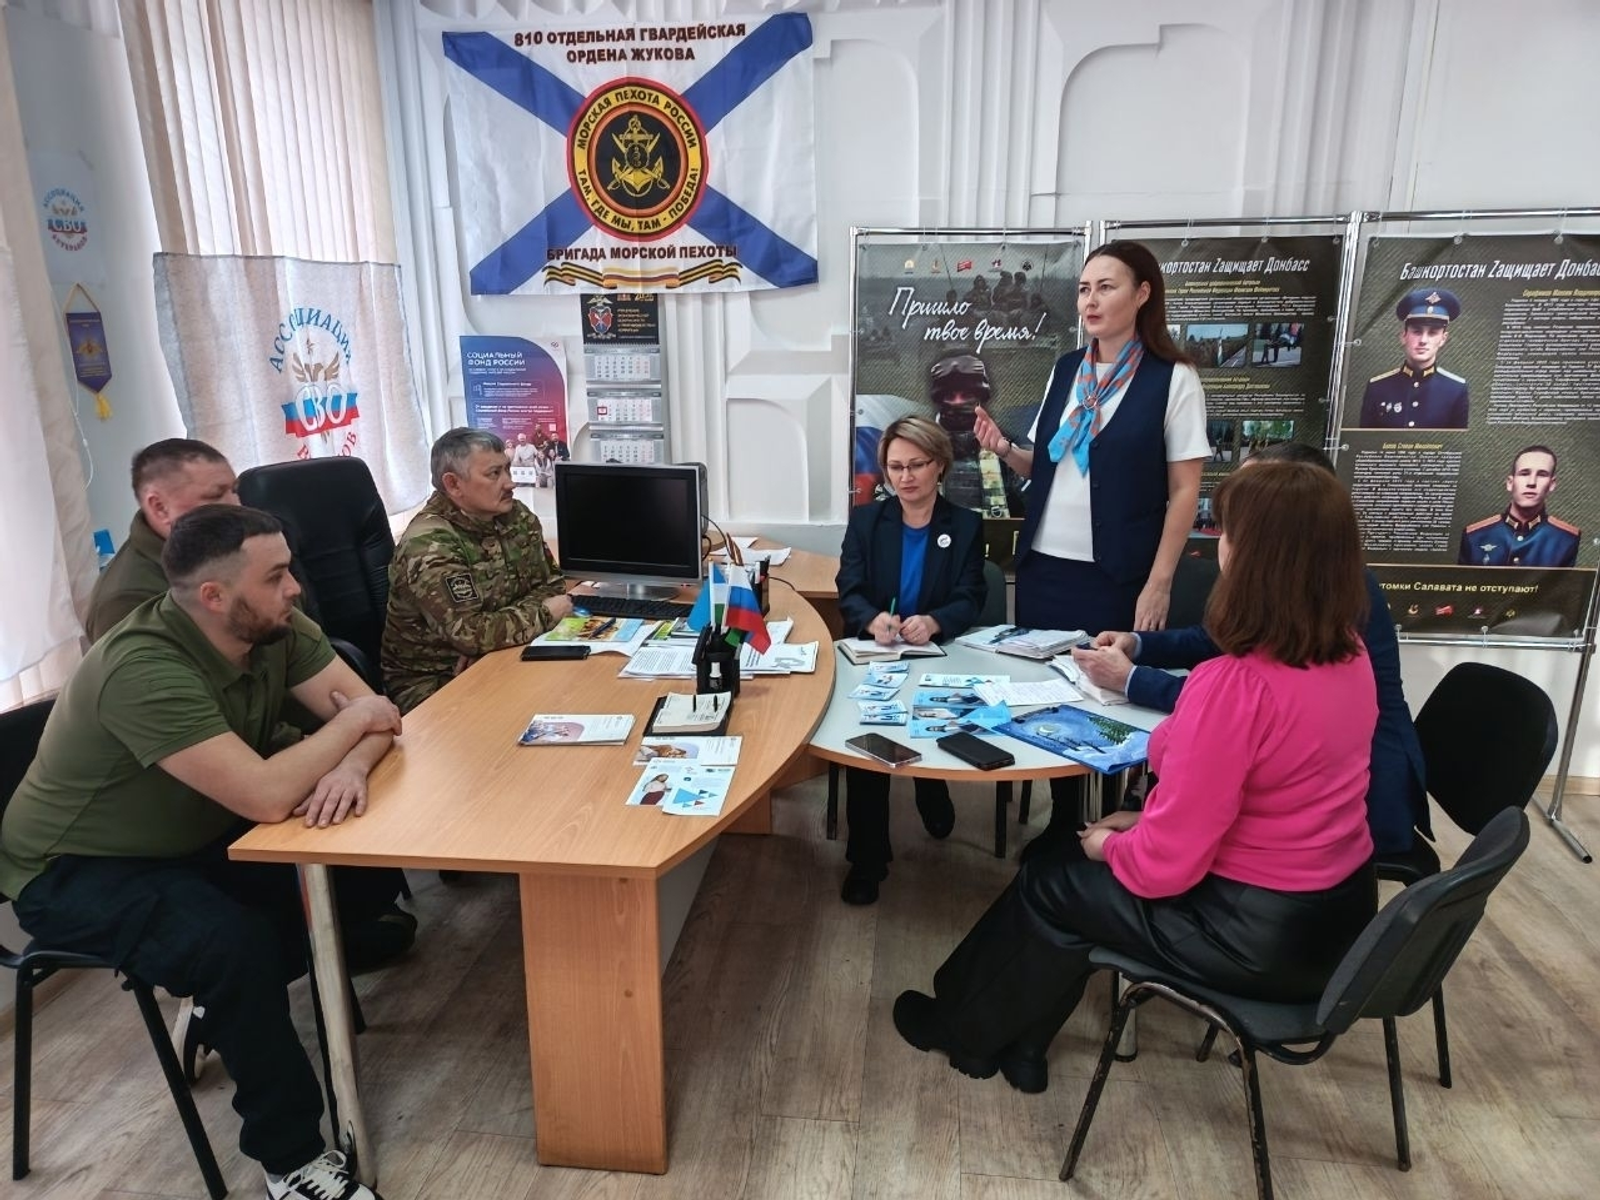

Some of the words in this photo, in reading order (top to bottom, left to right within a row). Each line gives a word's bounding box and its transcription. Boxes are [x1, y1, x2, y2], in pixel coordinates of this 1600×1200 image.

[514, 31, 543, 47] 810
[546, 28, 636, 46] ОТДЕЛЬНАЯ
[640, 23, 746, 43] ГВАРДЕЙСКАЯ
[566, 49, 628, 64] ОРДЕНА
[630, 47, 696, 62] ЖУКОВА
[577, 97, 612, 150] МОРСКАЯ
[615, 89, 660, 106] ПЕХОТА
[663, 102, 697, 149] РОССИИ
[591, 200, 609, 219] ГДЕ
[610, 215, 635, 232] МЫ,
[637, 218, 662, 230] ТАМ
[668, 167, 700, 219] ПОБЕДА!
[546, 247, 607, 262] БРИГАДА
[610, 245, 676, 260] МОРСКОЙ
[679, 245, 737, 258] ПЕХОТЫ
[1158, 261, 1212, 275] кортостан
[1264, 257, 1311, 275] Донбасс
[1400, 263, 1488, 281] Башкортостан
[888, 286, 973, 329] Пришло
[973, 312, 1048, 354] время!
[467, 351, 523, 359] СОЦИАЛЬНЫЙ
[295, 383, 348, 432] СВО
[1378, 582, 1412, 590] томки
[1413, 581, 1463, 592] Салавата
[1479, 585, 1539, 594] отступают!
